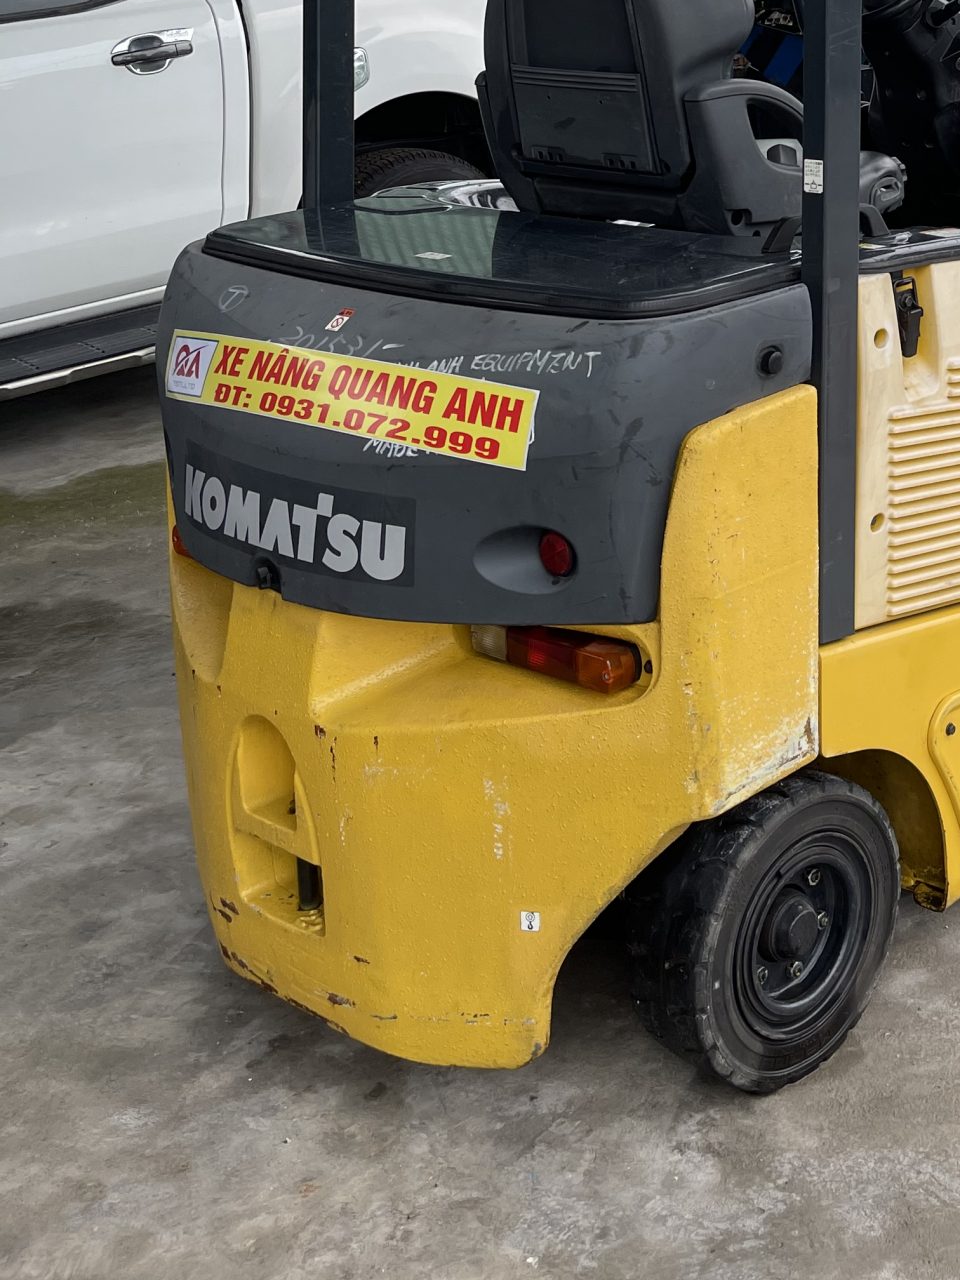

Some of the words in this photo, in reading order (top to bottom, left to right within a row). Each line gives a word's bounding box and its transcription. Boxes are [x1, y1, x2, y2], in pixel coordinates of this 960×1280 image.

[213, 344, 250, 378] XE
[247, 348, 326, 392] NÂNG
[328, 364, 438, 415] QUANG
[441, 386, 525, 434] ANH
[470, 350, 602, 377] EQUIPMENT
[213, 383, 253, 408] ĐT:
[258, 391, 501, 460] 0931.072.999
[184, 464, 406, 581] KOMATSU
